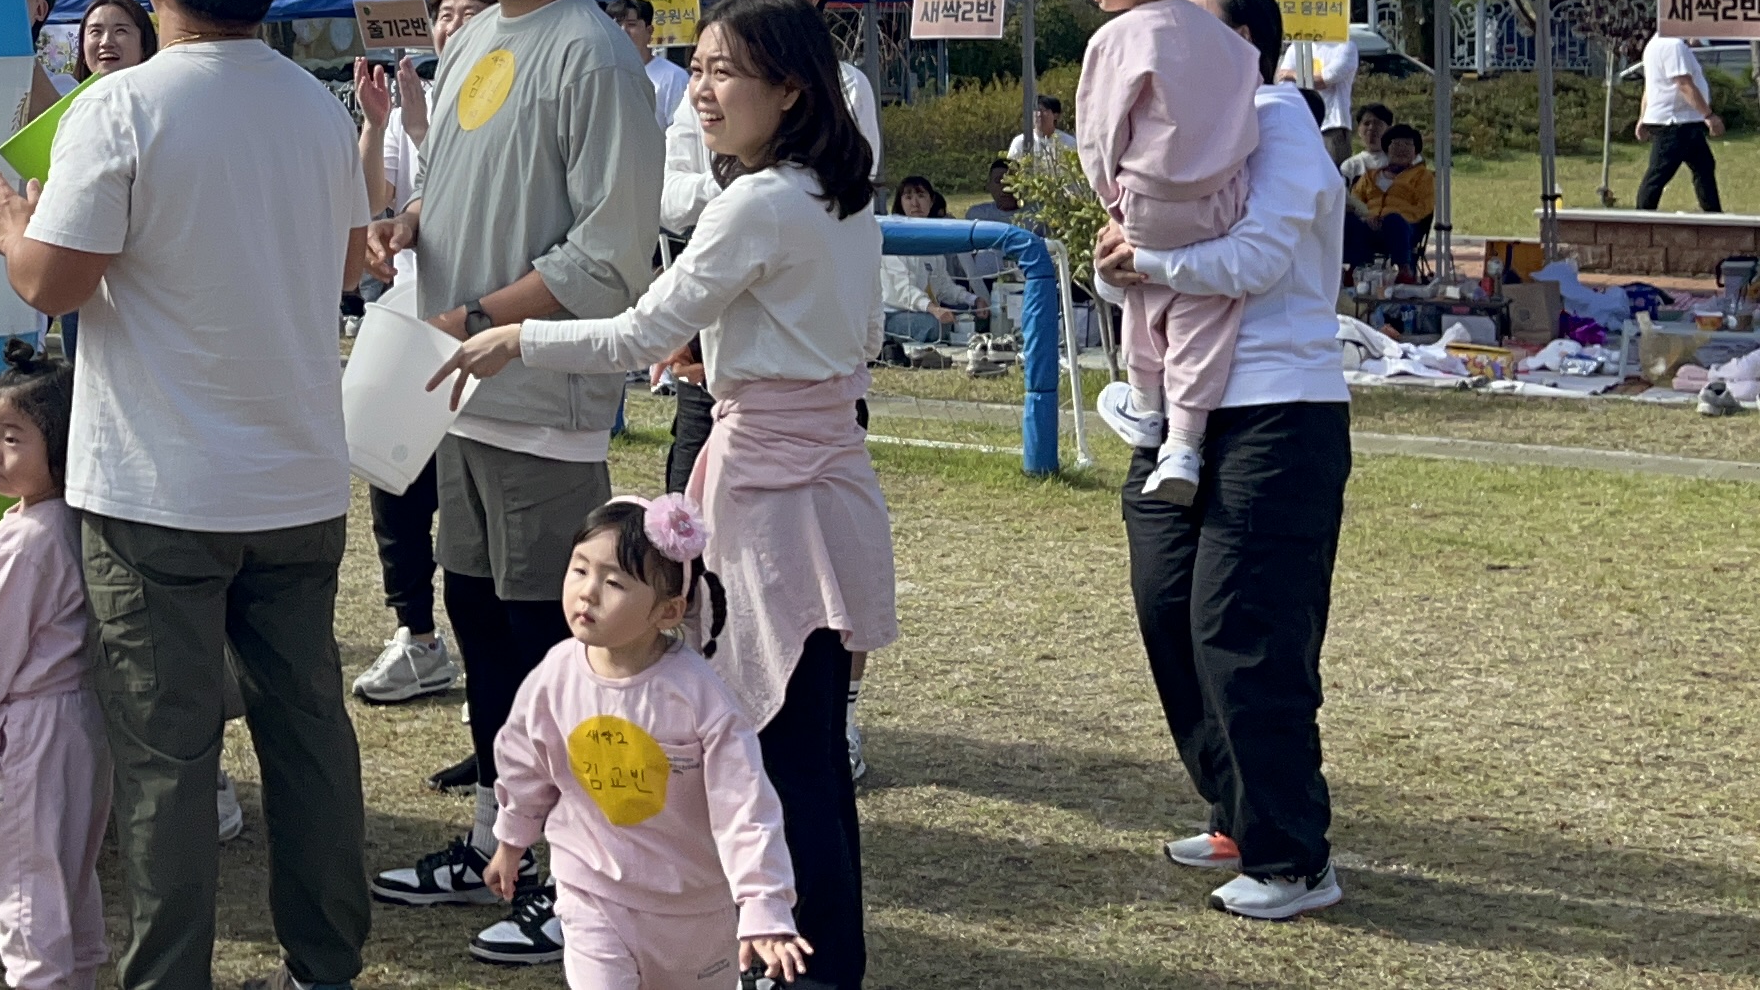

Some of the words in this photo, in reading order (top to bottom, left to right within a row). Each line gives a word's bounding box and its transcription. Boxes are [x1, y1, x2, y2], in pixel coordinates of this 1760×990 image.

[654, 8, 696, 25] 응원석
[920, 0, 997, 23] 새싹2반
[586, 729, 629, 746] 새싹2
[583, 761, 653, 795] 김교빈
